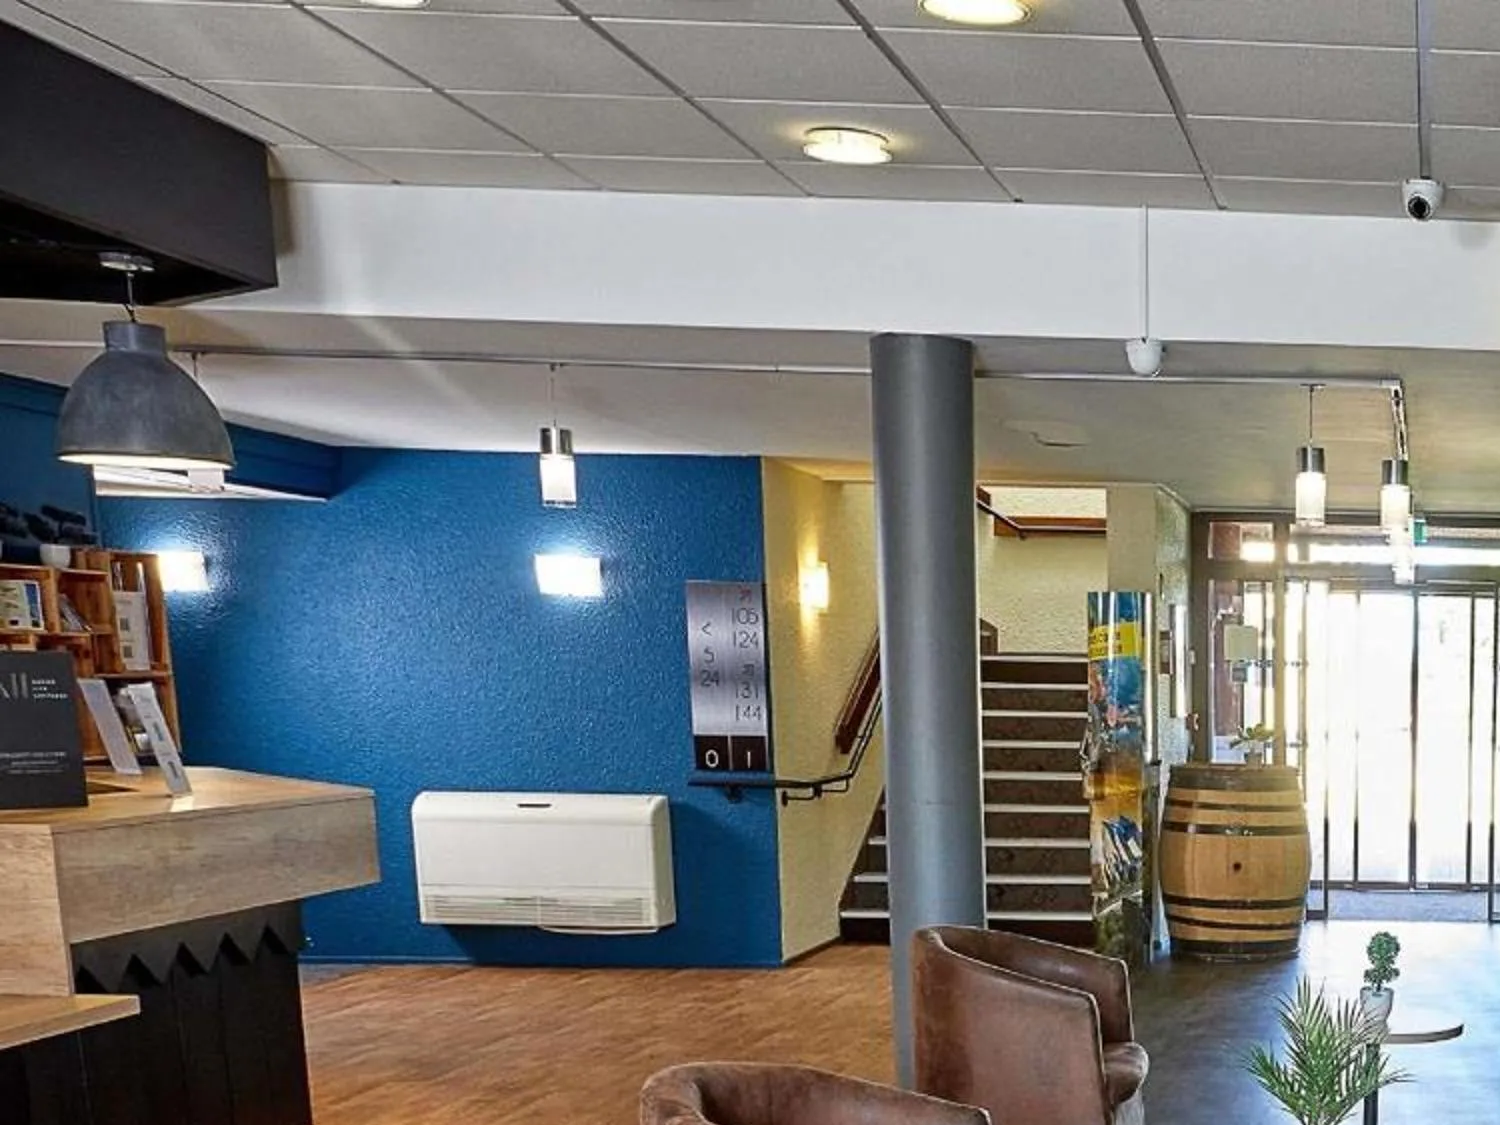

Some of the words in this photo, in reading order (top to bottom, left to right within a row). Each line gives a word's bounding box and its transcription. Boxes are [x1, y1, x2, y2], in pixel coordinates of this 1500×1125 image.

[731, 607, 759, 625] 105
[733, 631, 759, 649] 124
[700, 669, 719, 687] 24
[735, 704, 761, 721] 144
